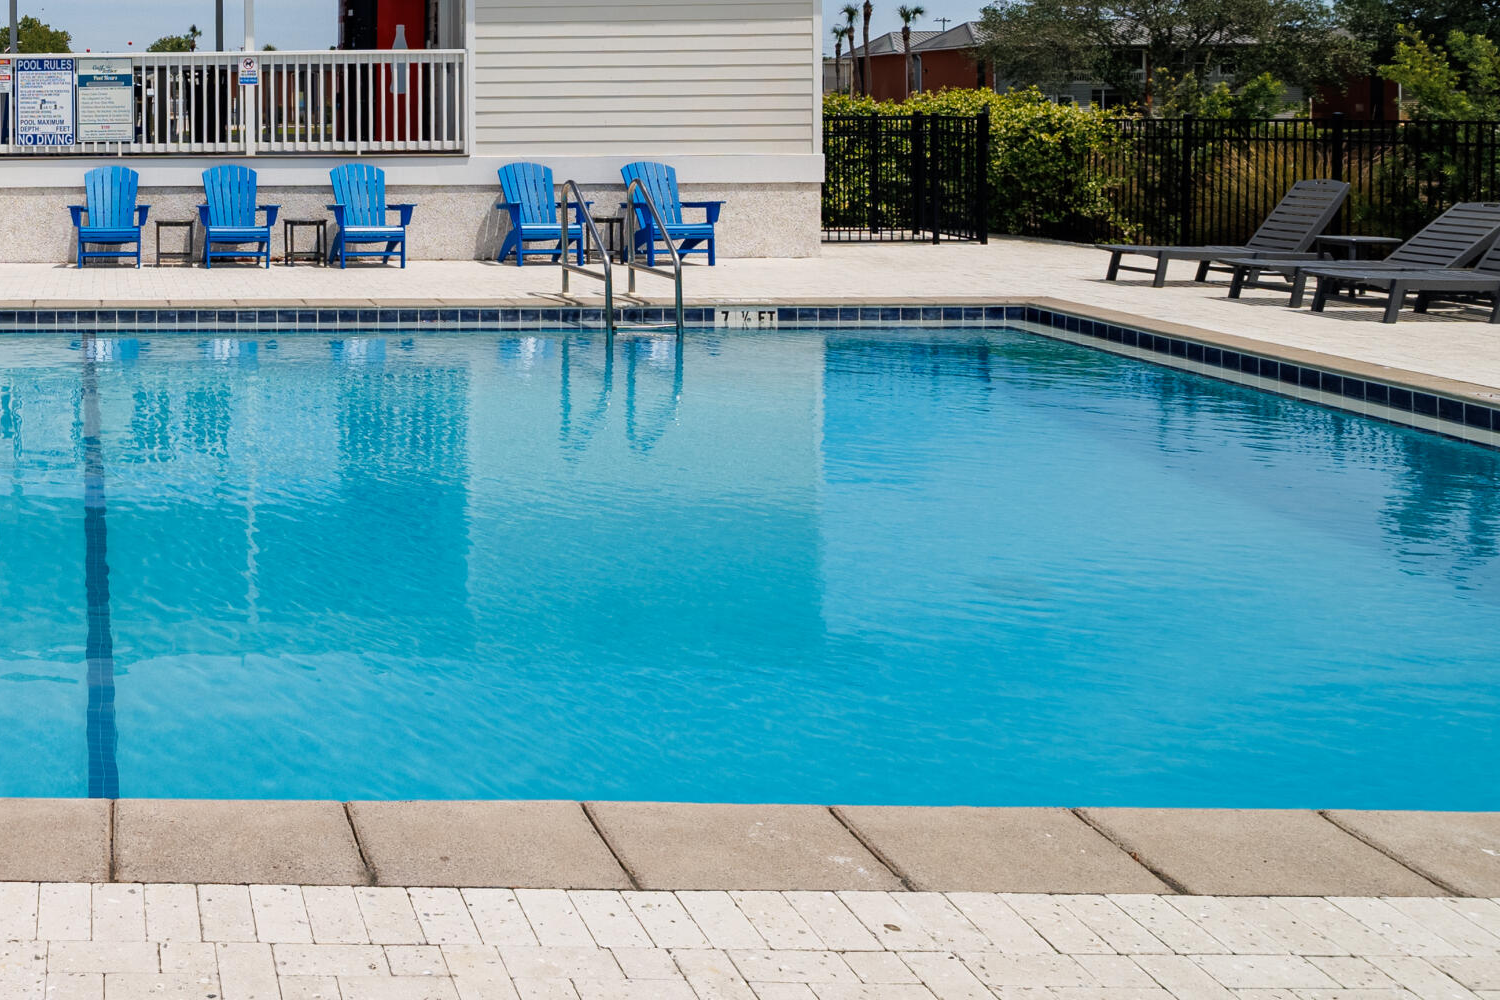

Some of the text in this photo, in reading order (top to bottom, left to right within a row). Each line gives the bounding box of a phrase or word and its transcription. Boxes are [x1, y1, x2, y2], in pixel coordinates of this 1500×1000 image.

[18, 60, 41, 70] POOL
[43, 60, 72, 70] RULES
[18, 134, 33, 145] NO
[37, 134, 73, 145] DIVING
[721, 310, 729, 321] 7
[758, 310, 776, 321] FT
